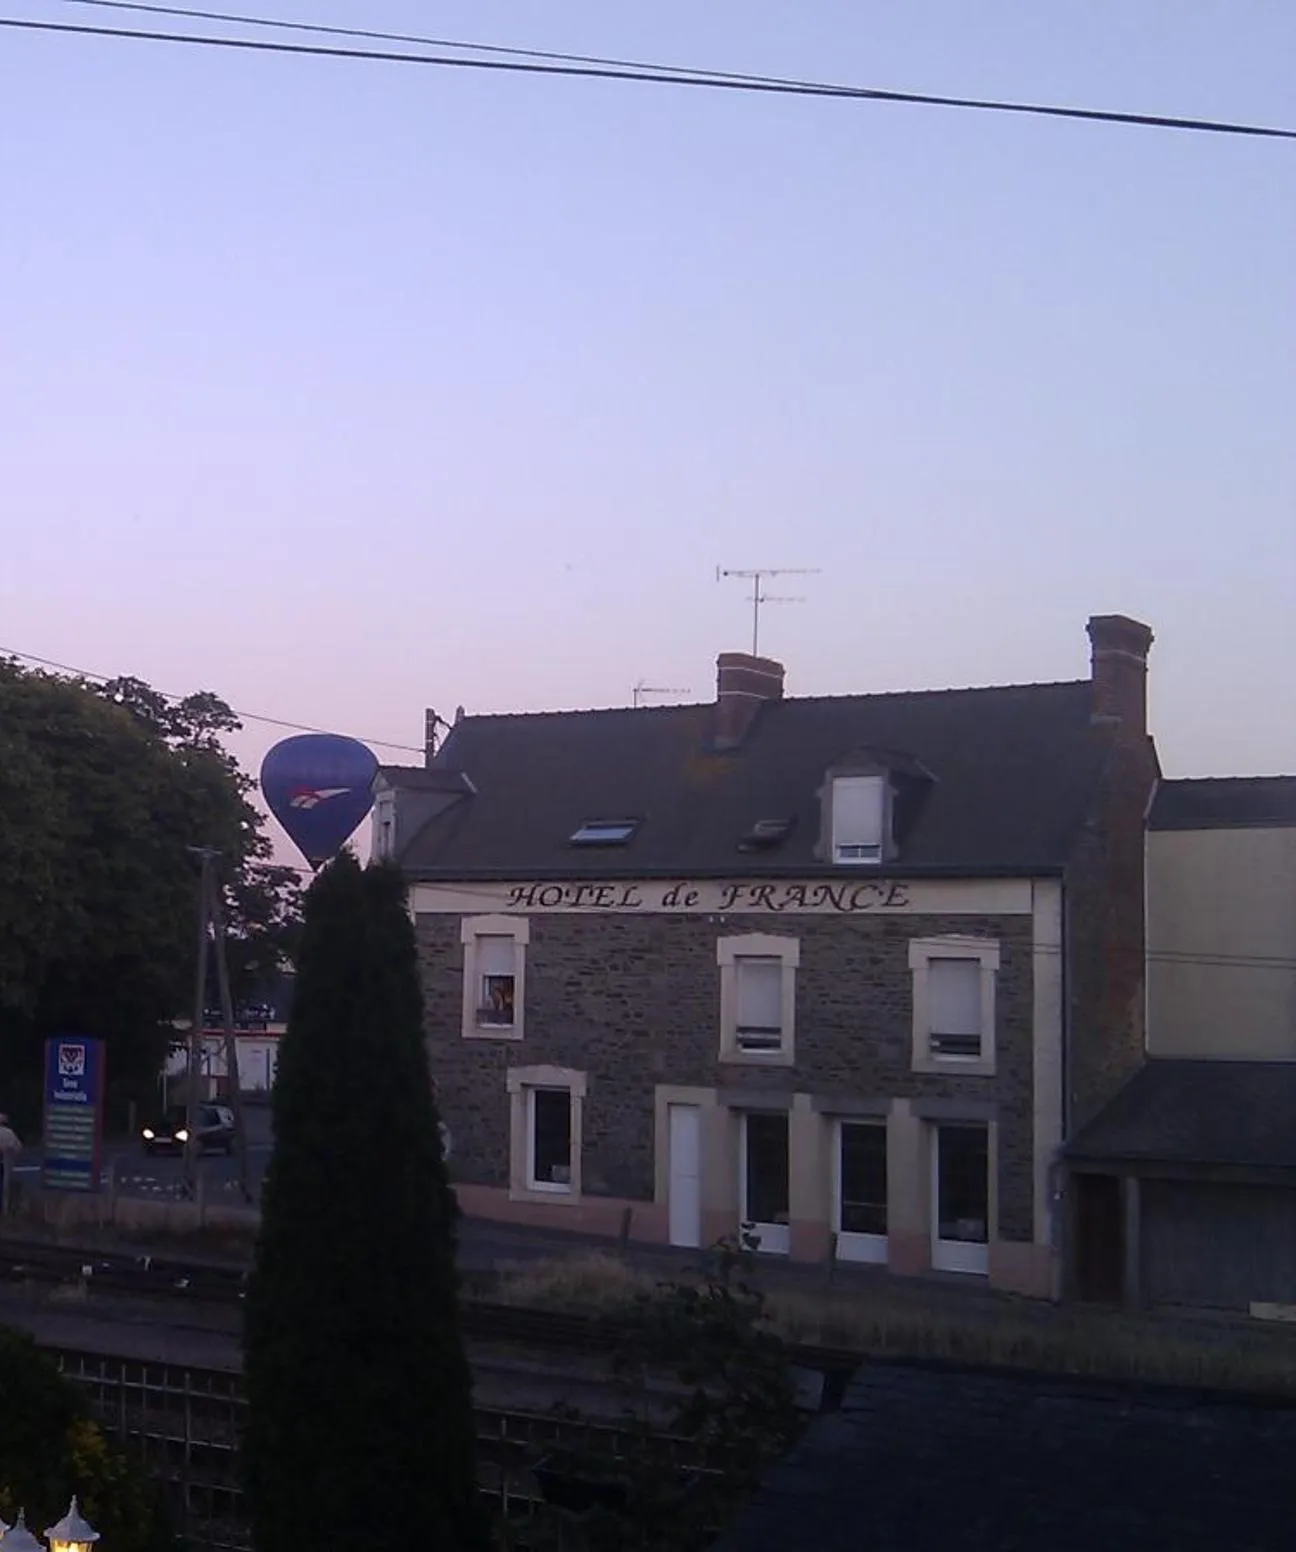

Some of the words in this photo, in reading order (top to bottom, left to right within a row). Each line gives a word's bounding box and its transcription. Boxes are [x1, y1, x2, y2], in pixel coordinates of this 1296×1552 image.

[507, 883, 643, 907] HOTEL
[662, 883, 701, 908] de
[718, 883, 910, 912] FRANCE
